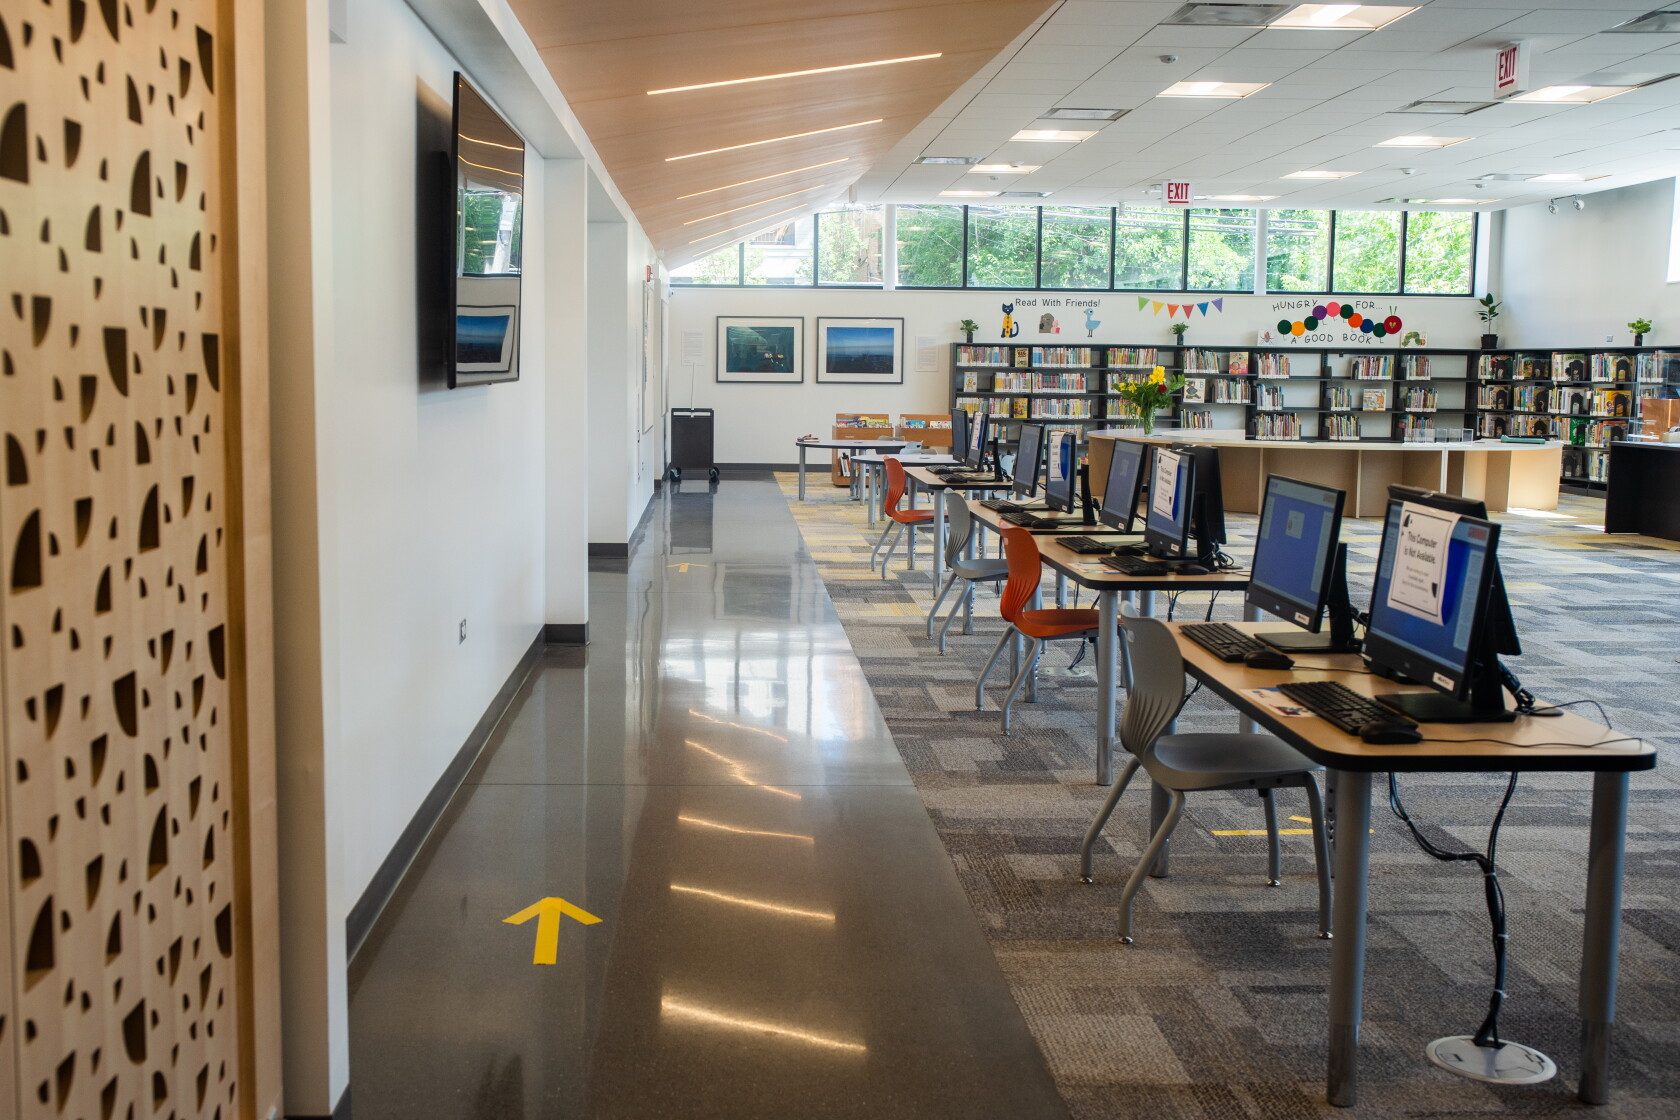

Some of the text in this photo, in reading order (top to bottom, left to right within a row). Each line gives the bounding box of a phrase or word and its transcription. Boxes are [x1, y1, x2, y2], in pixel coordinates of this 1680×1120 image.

[1499, 47, 1517, 81] EXIT
[1168, 183, 1190, 199] EXIT
[1015, 298, 1101, 308] Read With Friends!
[1272, 299, 1318, 312] HUNGRY
[1290, 333, 1372, 344] A GOOD BOOK
